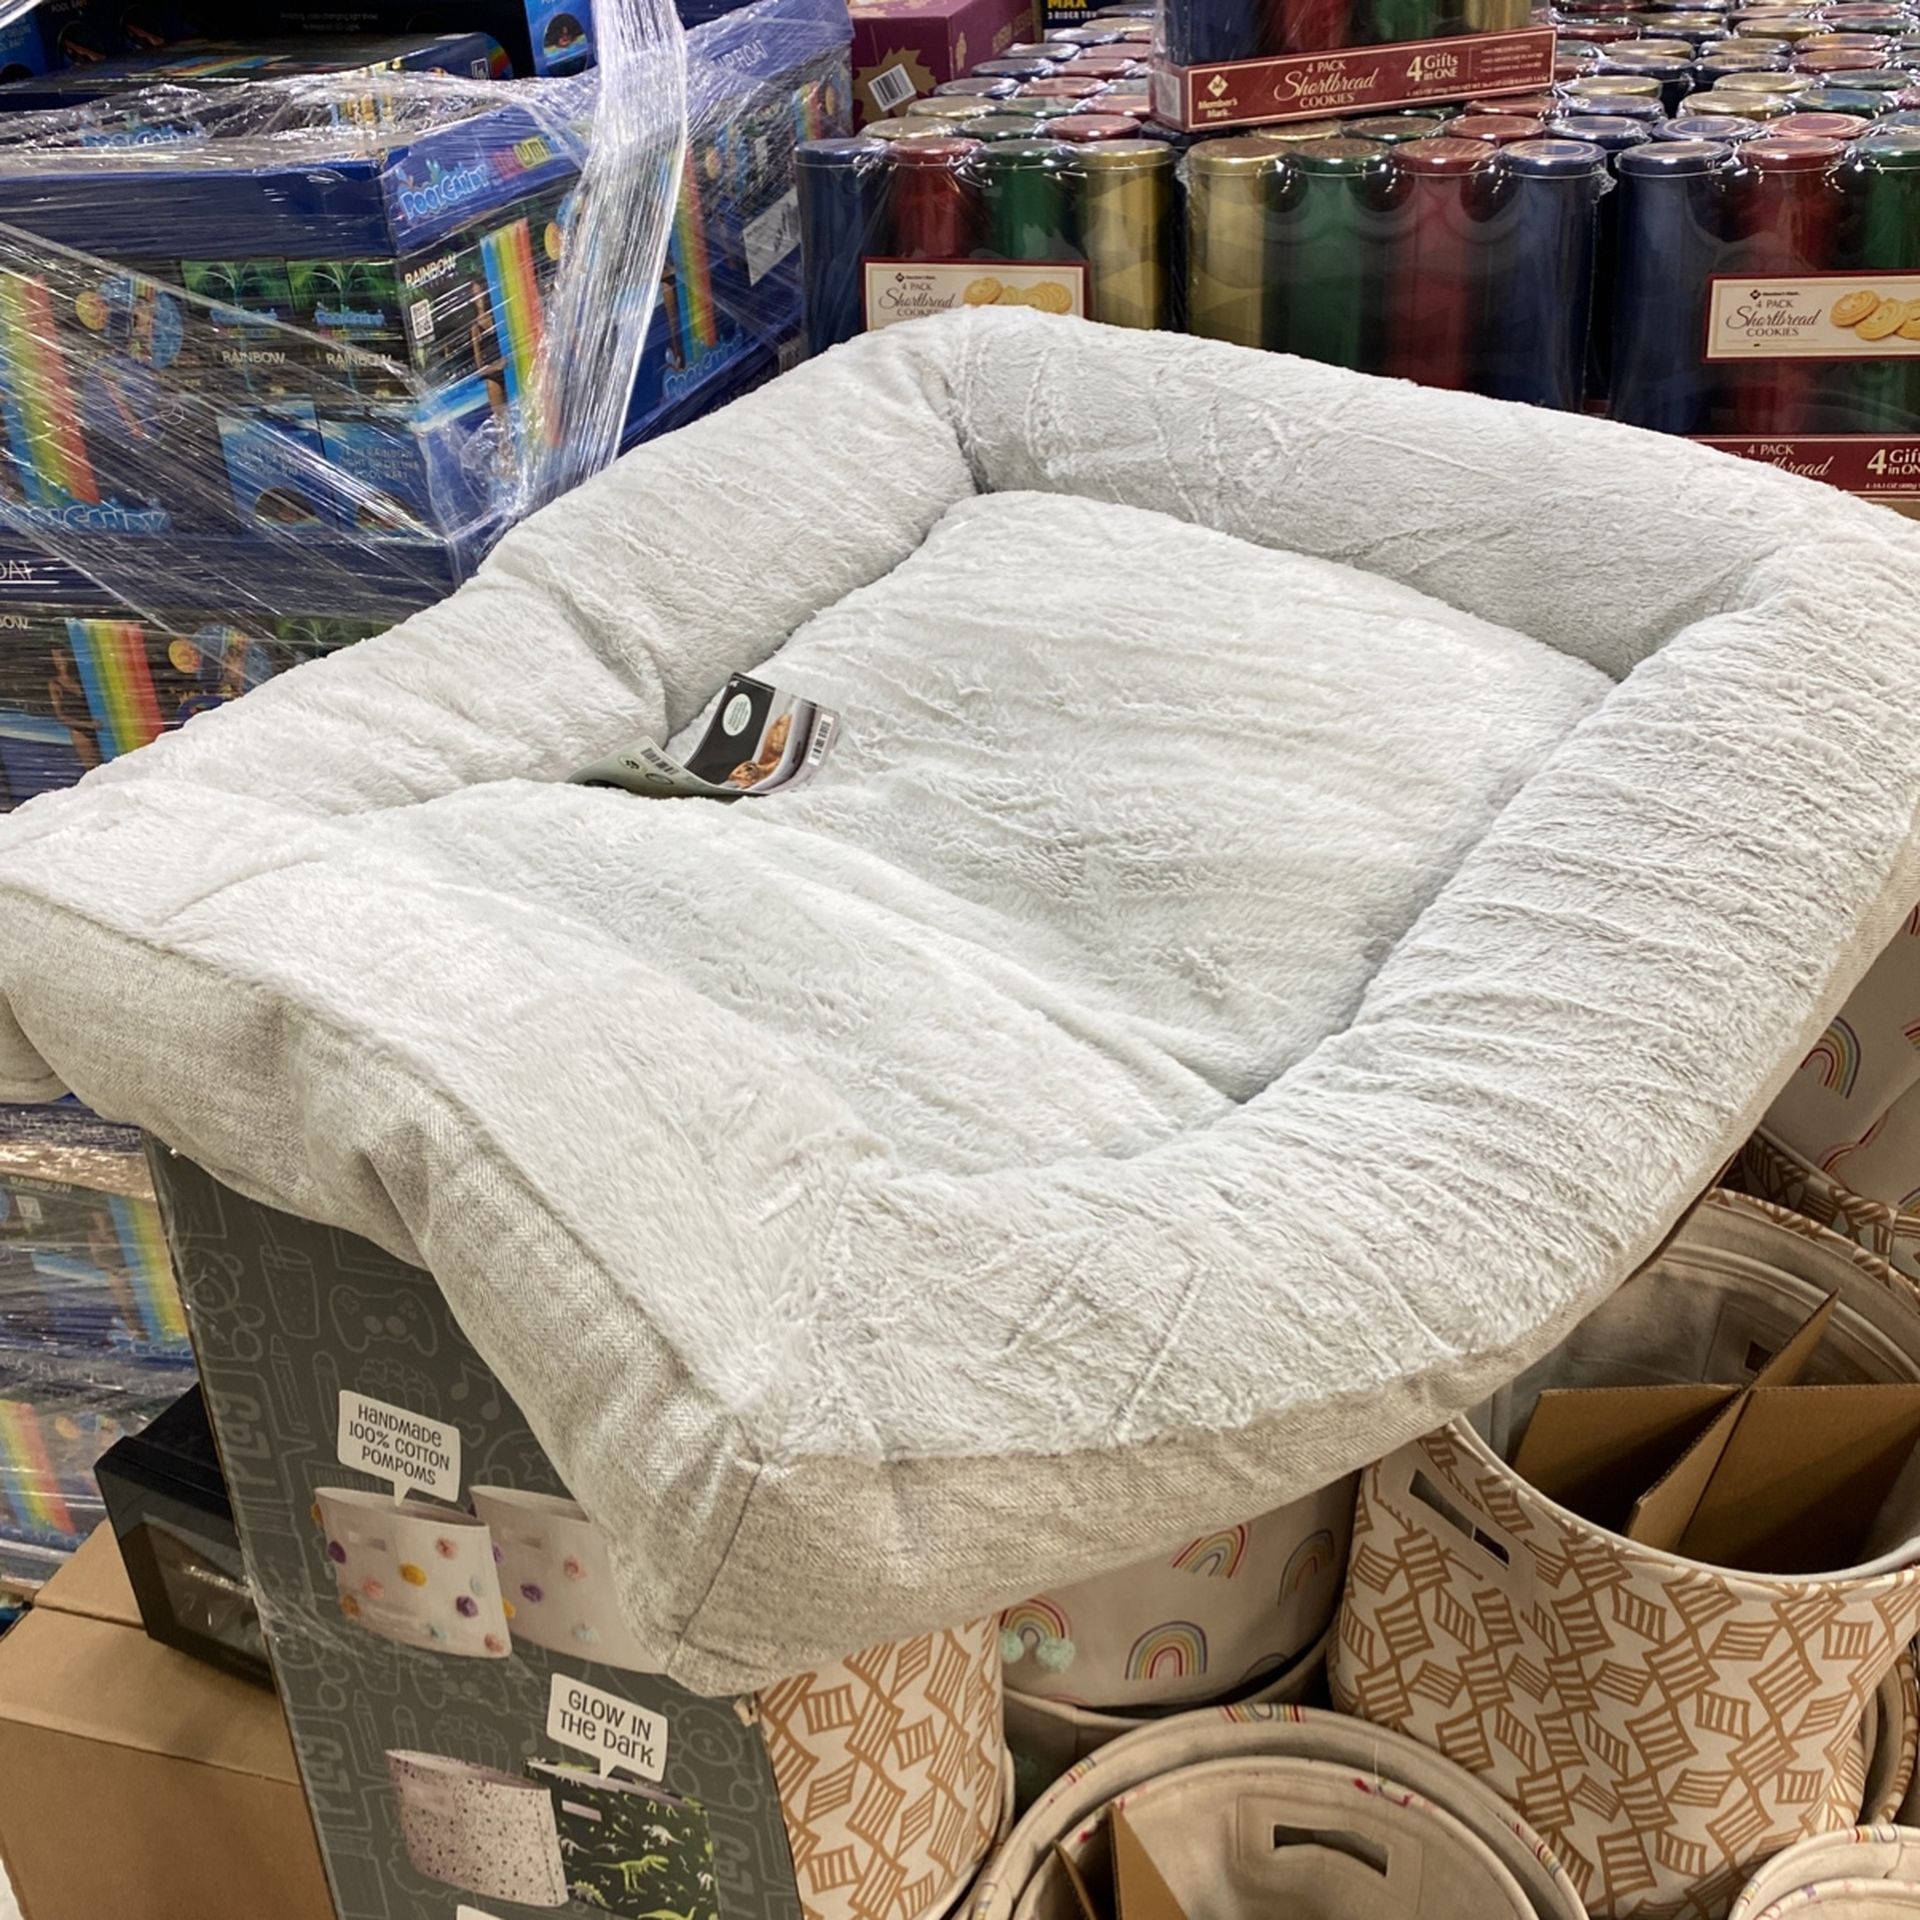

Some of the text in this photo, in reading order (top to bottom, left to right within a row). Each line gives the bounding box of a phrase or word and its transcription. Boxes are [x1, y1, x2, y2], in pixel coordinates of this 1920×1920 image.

[1307, 59, 1346, 73] 4 PACK
[1406, 56, 1423, 82] 4
[1424, 53, 1458, 70] Gifts
[1424, 67, 1458, 80] in ONE
[1274, 67, 1380, 101] Shortbread
[1300, 93, 1354, 108] COOKIES
[911, 283, 932, 291] PACK
[879, 287, 956, 310] Shortbread
[1766, 300, 1794, 308] PACK
[1725, 305, 1822, 329] Shortbread
[1746, 328, 1799, 337] COOKIES
[222, 351, 285, 365] RAINBOW
[1747, 444, 1795, 456] 4 PACK
[1867, 448, 1887, 475] 4
[1888, 463, 1900, 475] in
[349, 1420, 450, 1471] 100% COTTON
[362, 1445, 436, 1486] POMPOMS
[568, 1689, 652, 1741] GLOW IN
